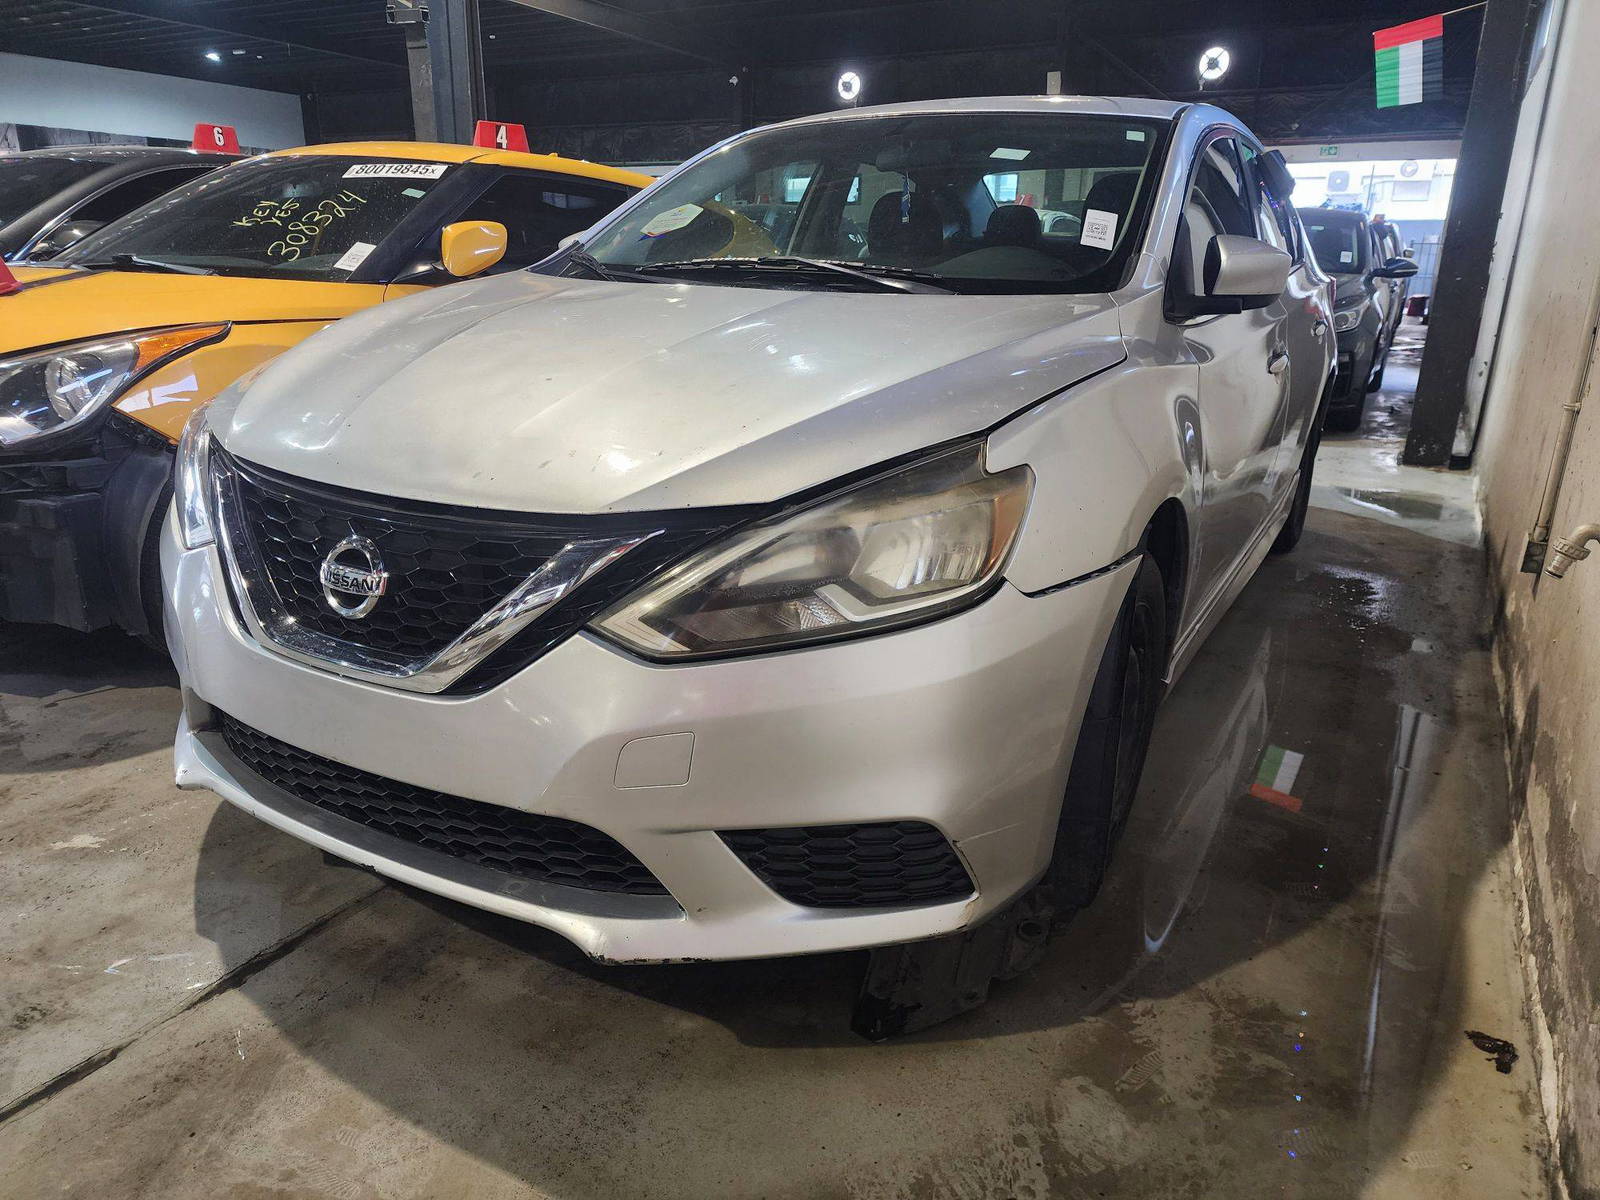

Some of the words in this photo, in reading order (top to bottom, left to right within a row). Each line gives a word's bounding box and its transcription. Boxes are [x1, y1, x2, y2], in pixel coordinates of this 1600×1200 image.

[213, 126, 225, 146] 6
[496, 125, 508, 149] 4
[267, 189, 367, 262] 308324
